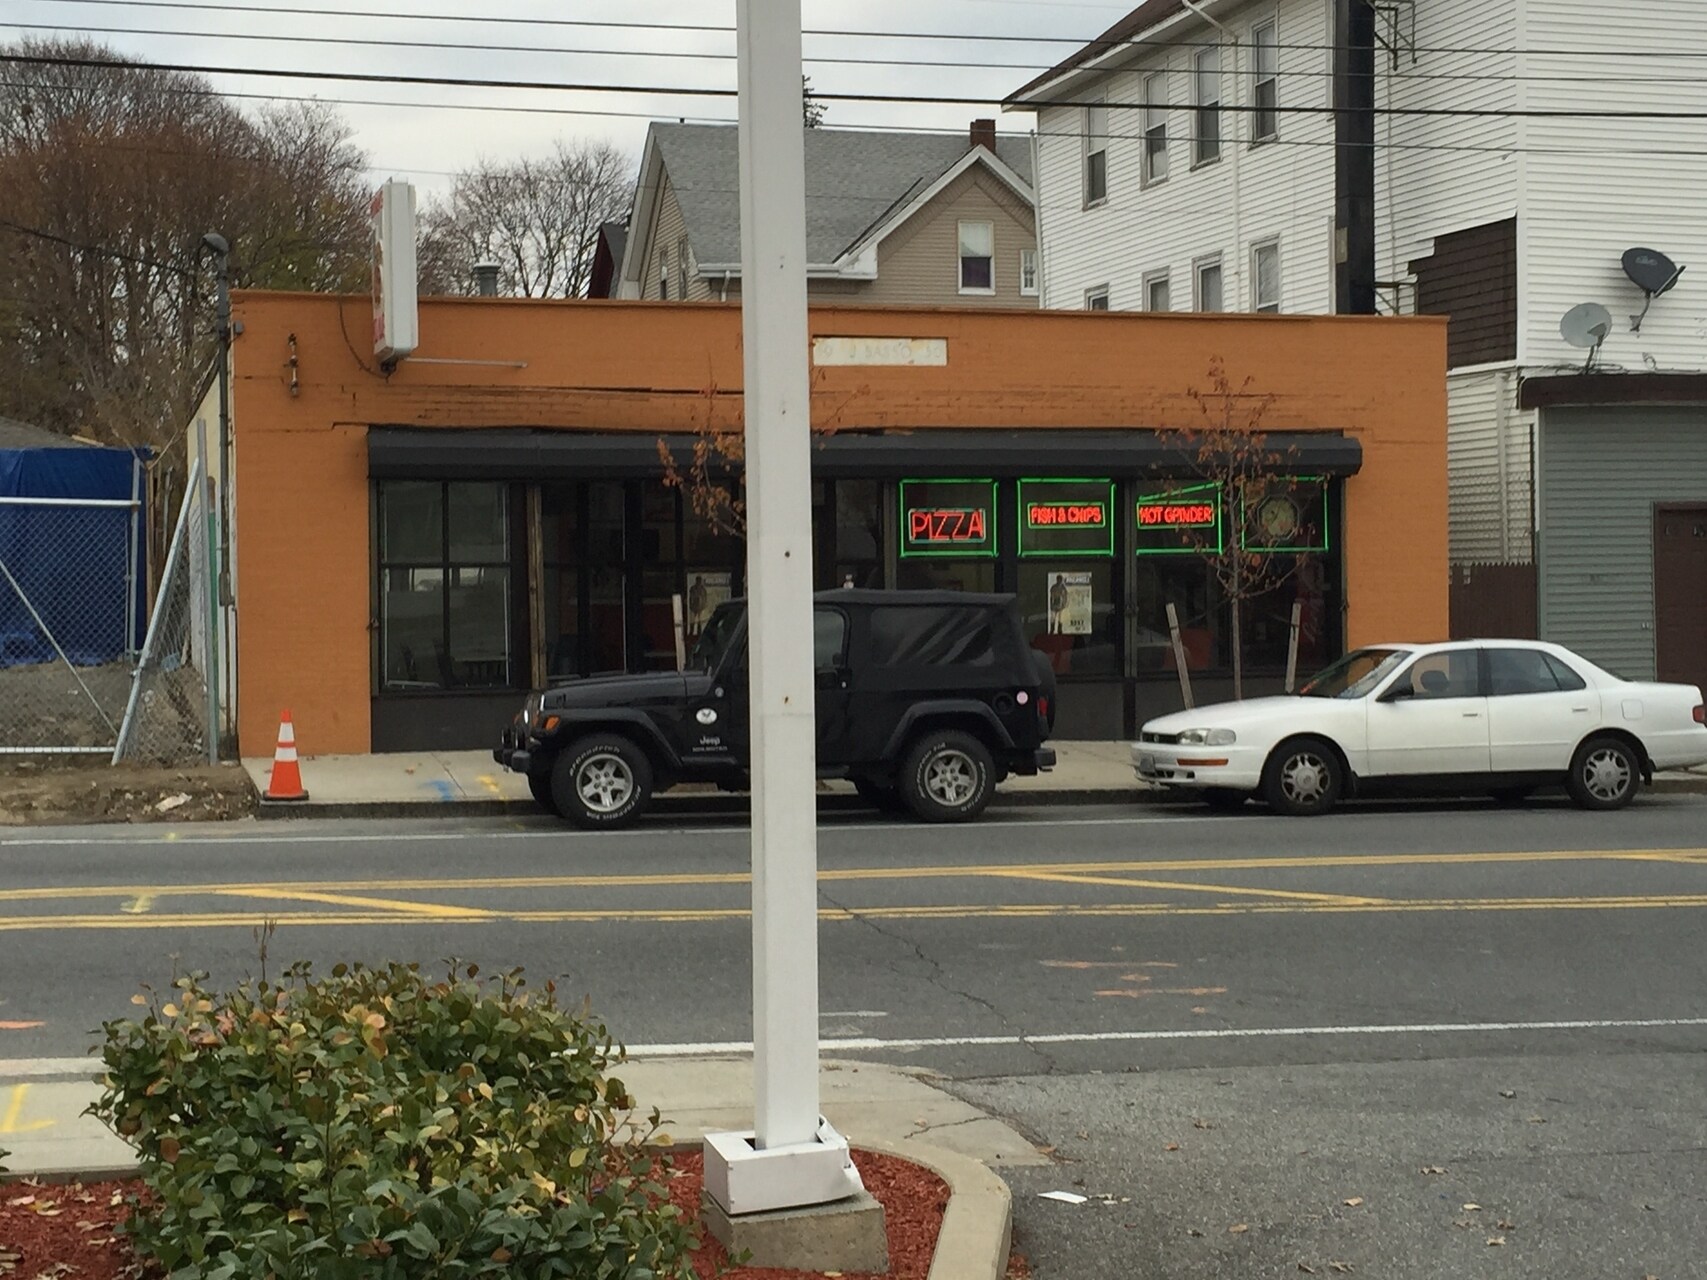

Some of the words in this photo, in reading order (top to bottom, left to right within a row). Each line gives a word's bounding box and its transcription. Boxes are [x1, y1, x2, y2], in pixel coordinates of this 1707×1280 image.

[1031, 506, 1056, 524] FISH
[1057, 506, 1066, 523] &
[1067, 506, 1102, 523] CHIPS
[1139, 506, 1163, 524] HOT
[912, 510, 984, 540] PIZZA
